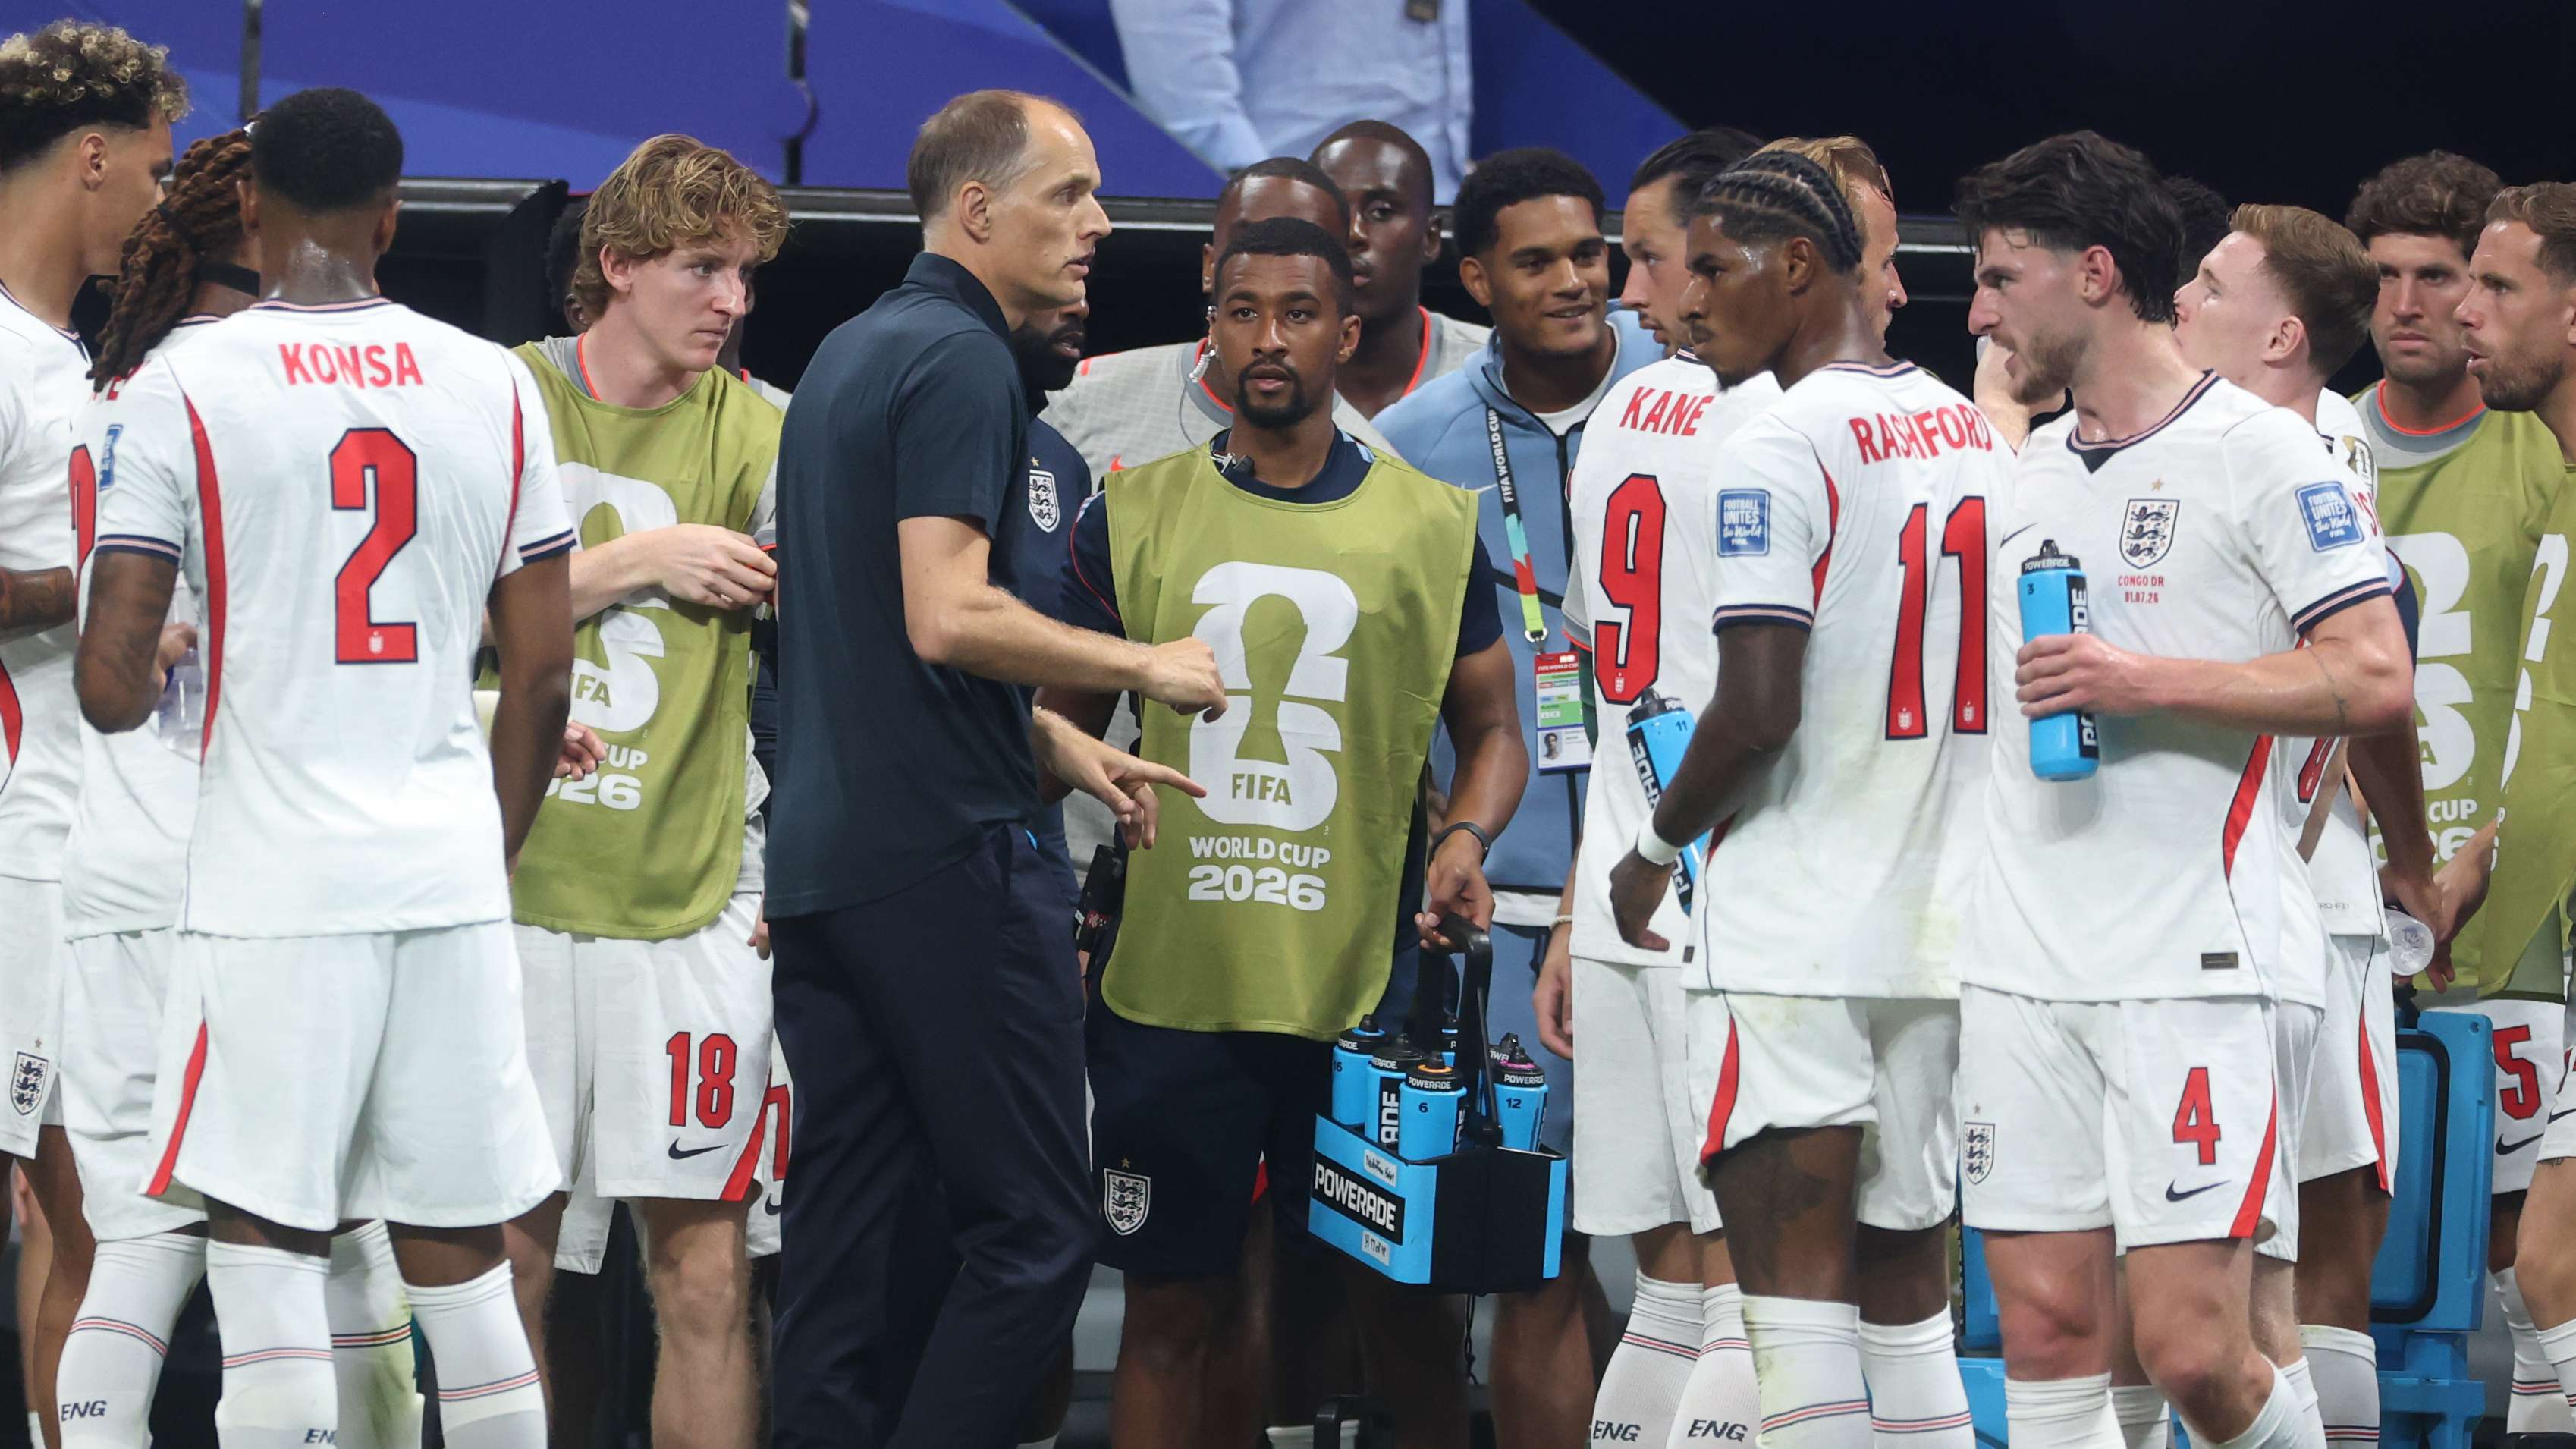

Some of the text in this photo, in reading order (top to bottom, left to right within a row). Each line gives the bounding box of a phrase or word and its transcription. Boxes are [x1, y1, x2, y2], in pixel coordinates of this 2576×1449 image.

[278, 342, 423, 389] KONSA
[1619, 386, 1715, 436] KANE
[1849, 404, 1992, 465] RASHFORD
[1491, 432, 1508, 476] WORLD
[1500, 476, 1514, 503] FIFA
[1723, 511, 1759, 525] UNITES
[2311, 501, 2347, 520] UNITES
[328, 427, 418, 664] 2
[2024, 558, 2071, 570] POWERADE
[1594, 473, 1666, 706] 9
[2027, 583, 2034, 595] 3
[2118, 575, 2164, 586] CONGO DR
[2125, 591, 2159, 604] 01.07.26
[1885, 495, 1988, 741] 11
[572, 673, 611, 708] FA
[1676, 720, 1688, 732] 11
[545, 772, 642, 810] 26
[1232, 773, 1292, 806] FIFA
[2427, 799, 2477, 823] CUP
[1189, 836, 1331, 869] WORLD CUP
[1189, 864, 1327, 911] 2026
[666, 1031, 738, 1129] 18
[1409, 1077, 1452, 1089] POWERADE
[1504, 1073, 1544, 1084] POWERADE
[2493, 1024, 2541, 1121] 5
[1418, 1102, 1428, 1113] 6
[1506, 1098, 1522, 1109] 12
[2172, 1066, 2221, 1165] 4
[1314, 1162, 1396, 1232] POWERADE
[61, 1400, 108, 1421] ENG
[305, 1428, 337, 1444] EN
[1593, 1419, 1641, 1441] ENG
[1687, 1419, 1748, 1442] ENG
